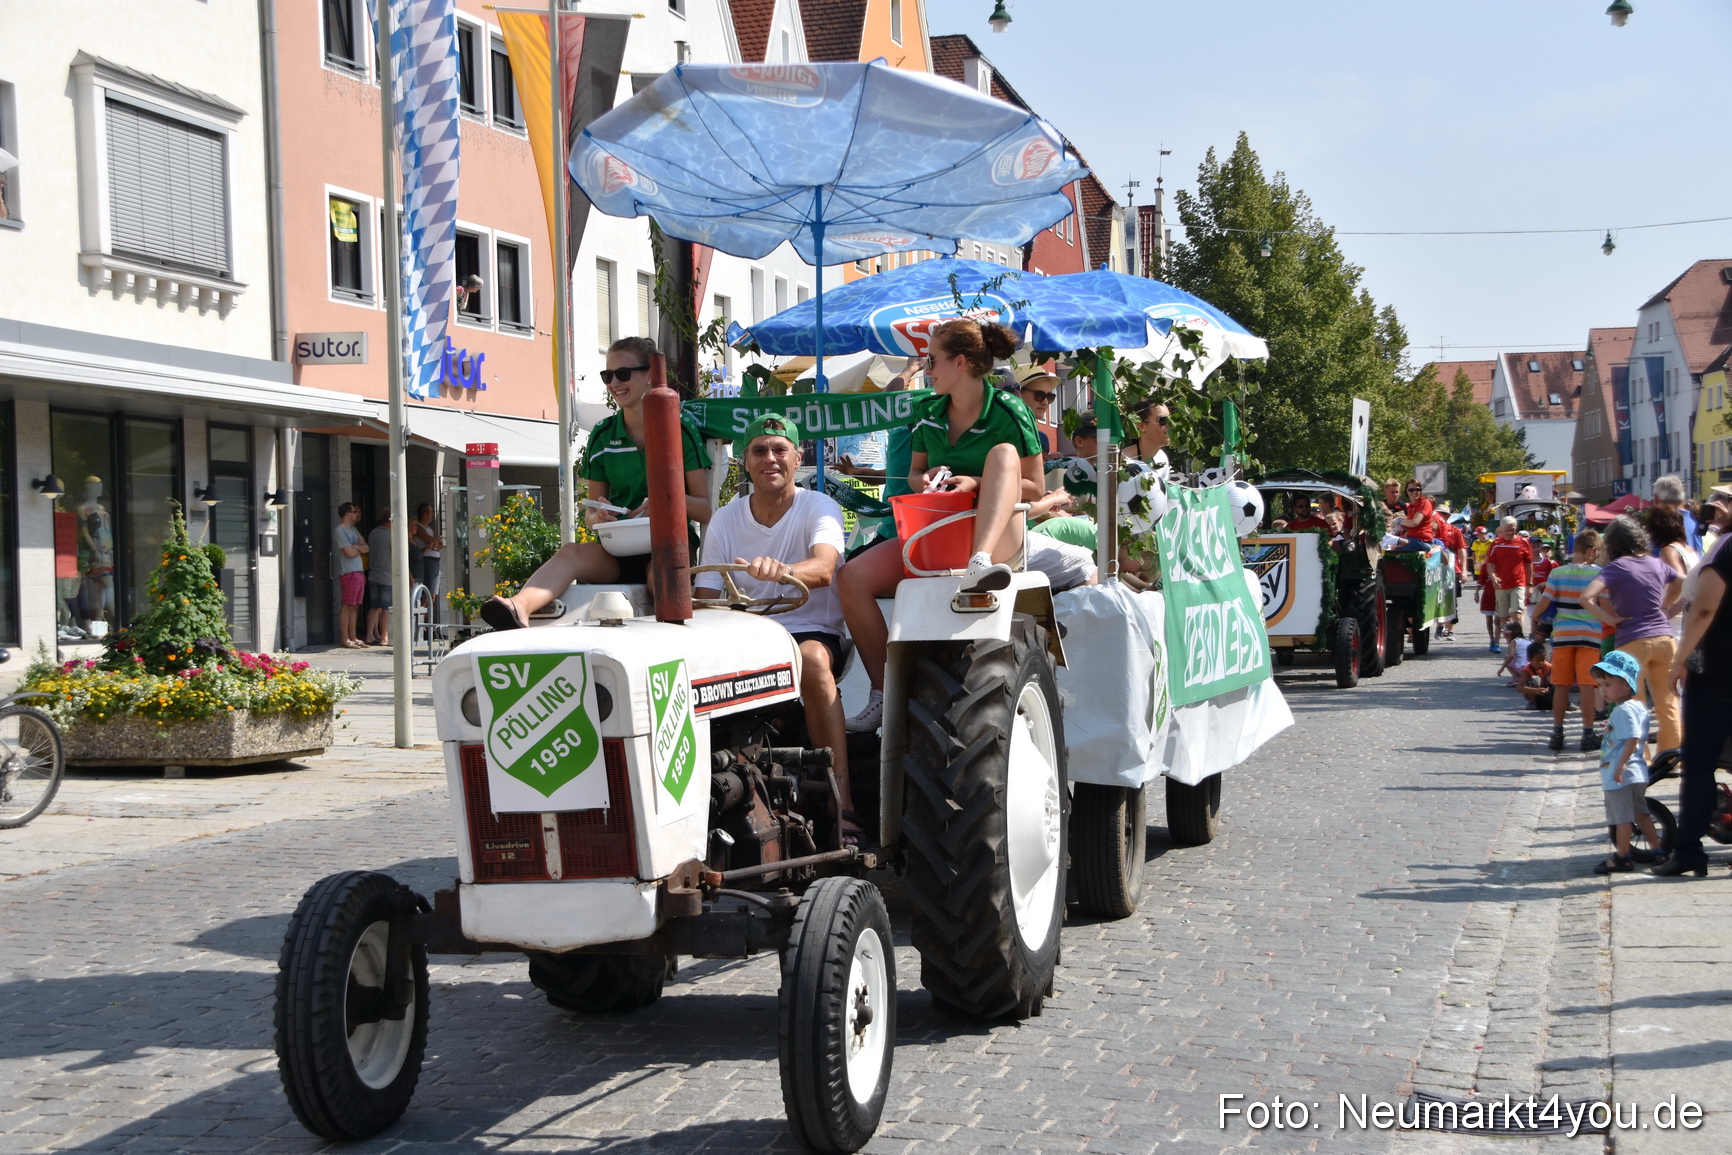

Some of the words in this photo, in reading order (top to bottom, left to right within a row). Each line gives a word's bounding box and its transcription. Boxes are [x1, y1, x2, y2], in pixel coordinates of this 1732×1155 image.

[786, 391, 914, 433] PÖLLING
[488, 662, 531, 690] SV
[652, 670, 669, 701] SV
[700, 681, 734, 704] BROWN
[734, 673, 777, 695] SELECTAMATIC
[496, 676, 577, 750] PÖLLING
[658, 683, 687, 762] PÖLLING
[530, 728, 582, 775] 1950
[671, 736, 690, 784] 1950
[485, 842, 530, 850] Livedrive
[500, 852, 517, 860] 12
